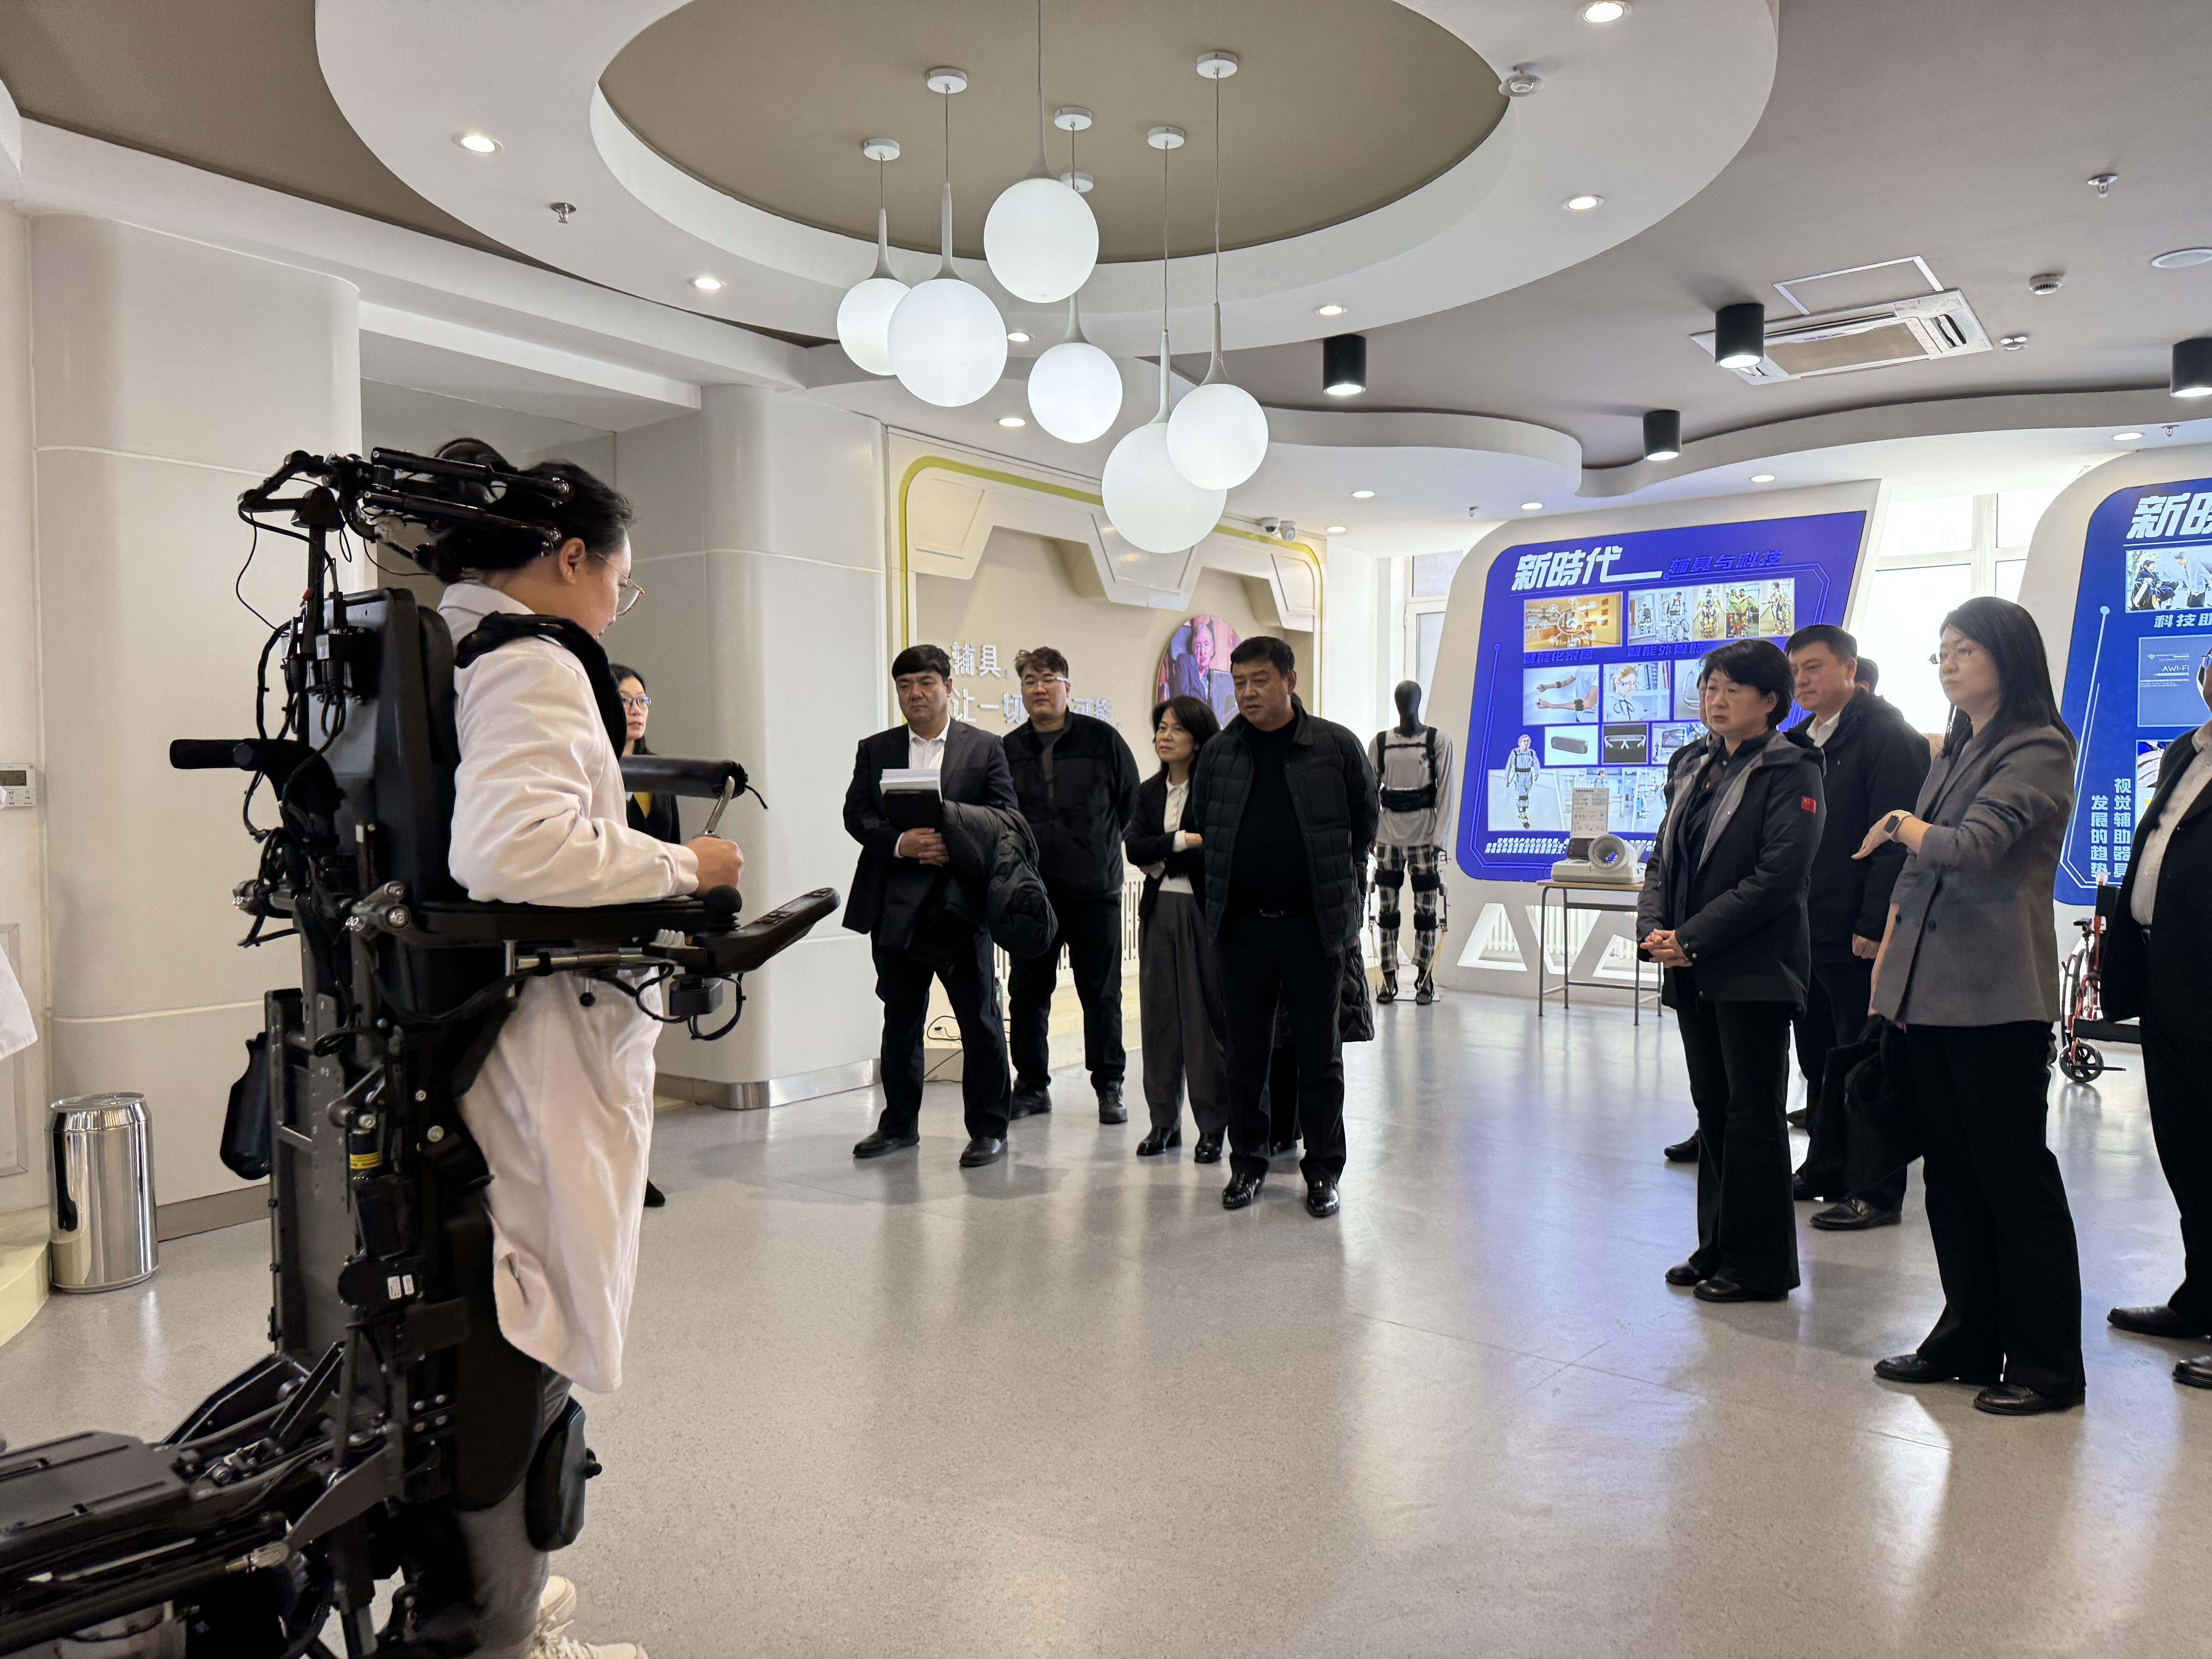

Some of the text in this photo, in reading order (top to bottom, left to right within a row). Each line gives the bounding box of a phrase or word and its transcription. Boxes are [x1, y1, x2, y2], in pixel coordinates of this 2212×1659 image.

[1511, 546, 1662, 591] 新時代
[1669, 550, 1783, 574] 辅具与科技
[1523, 649, 1593, 664] 智能化家居
[2114, 778, 2131, 878] 视觉辅助器具
